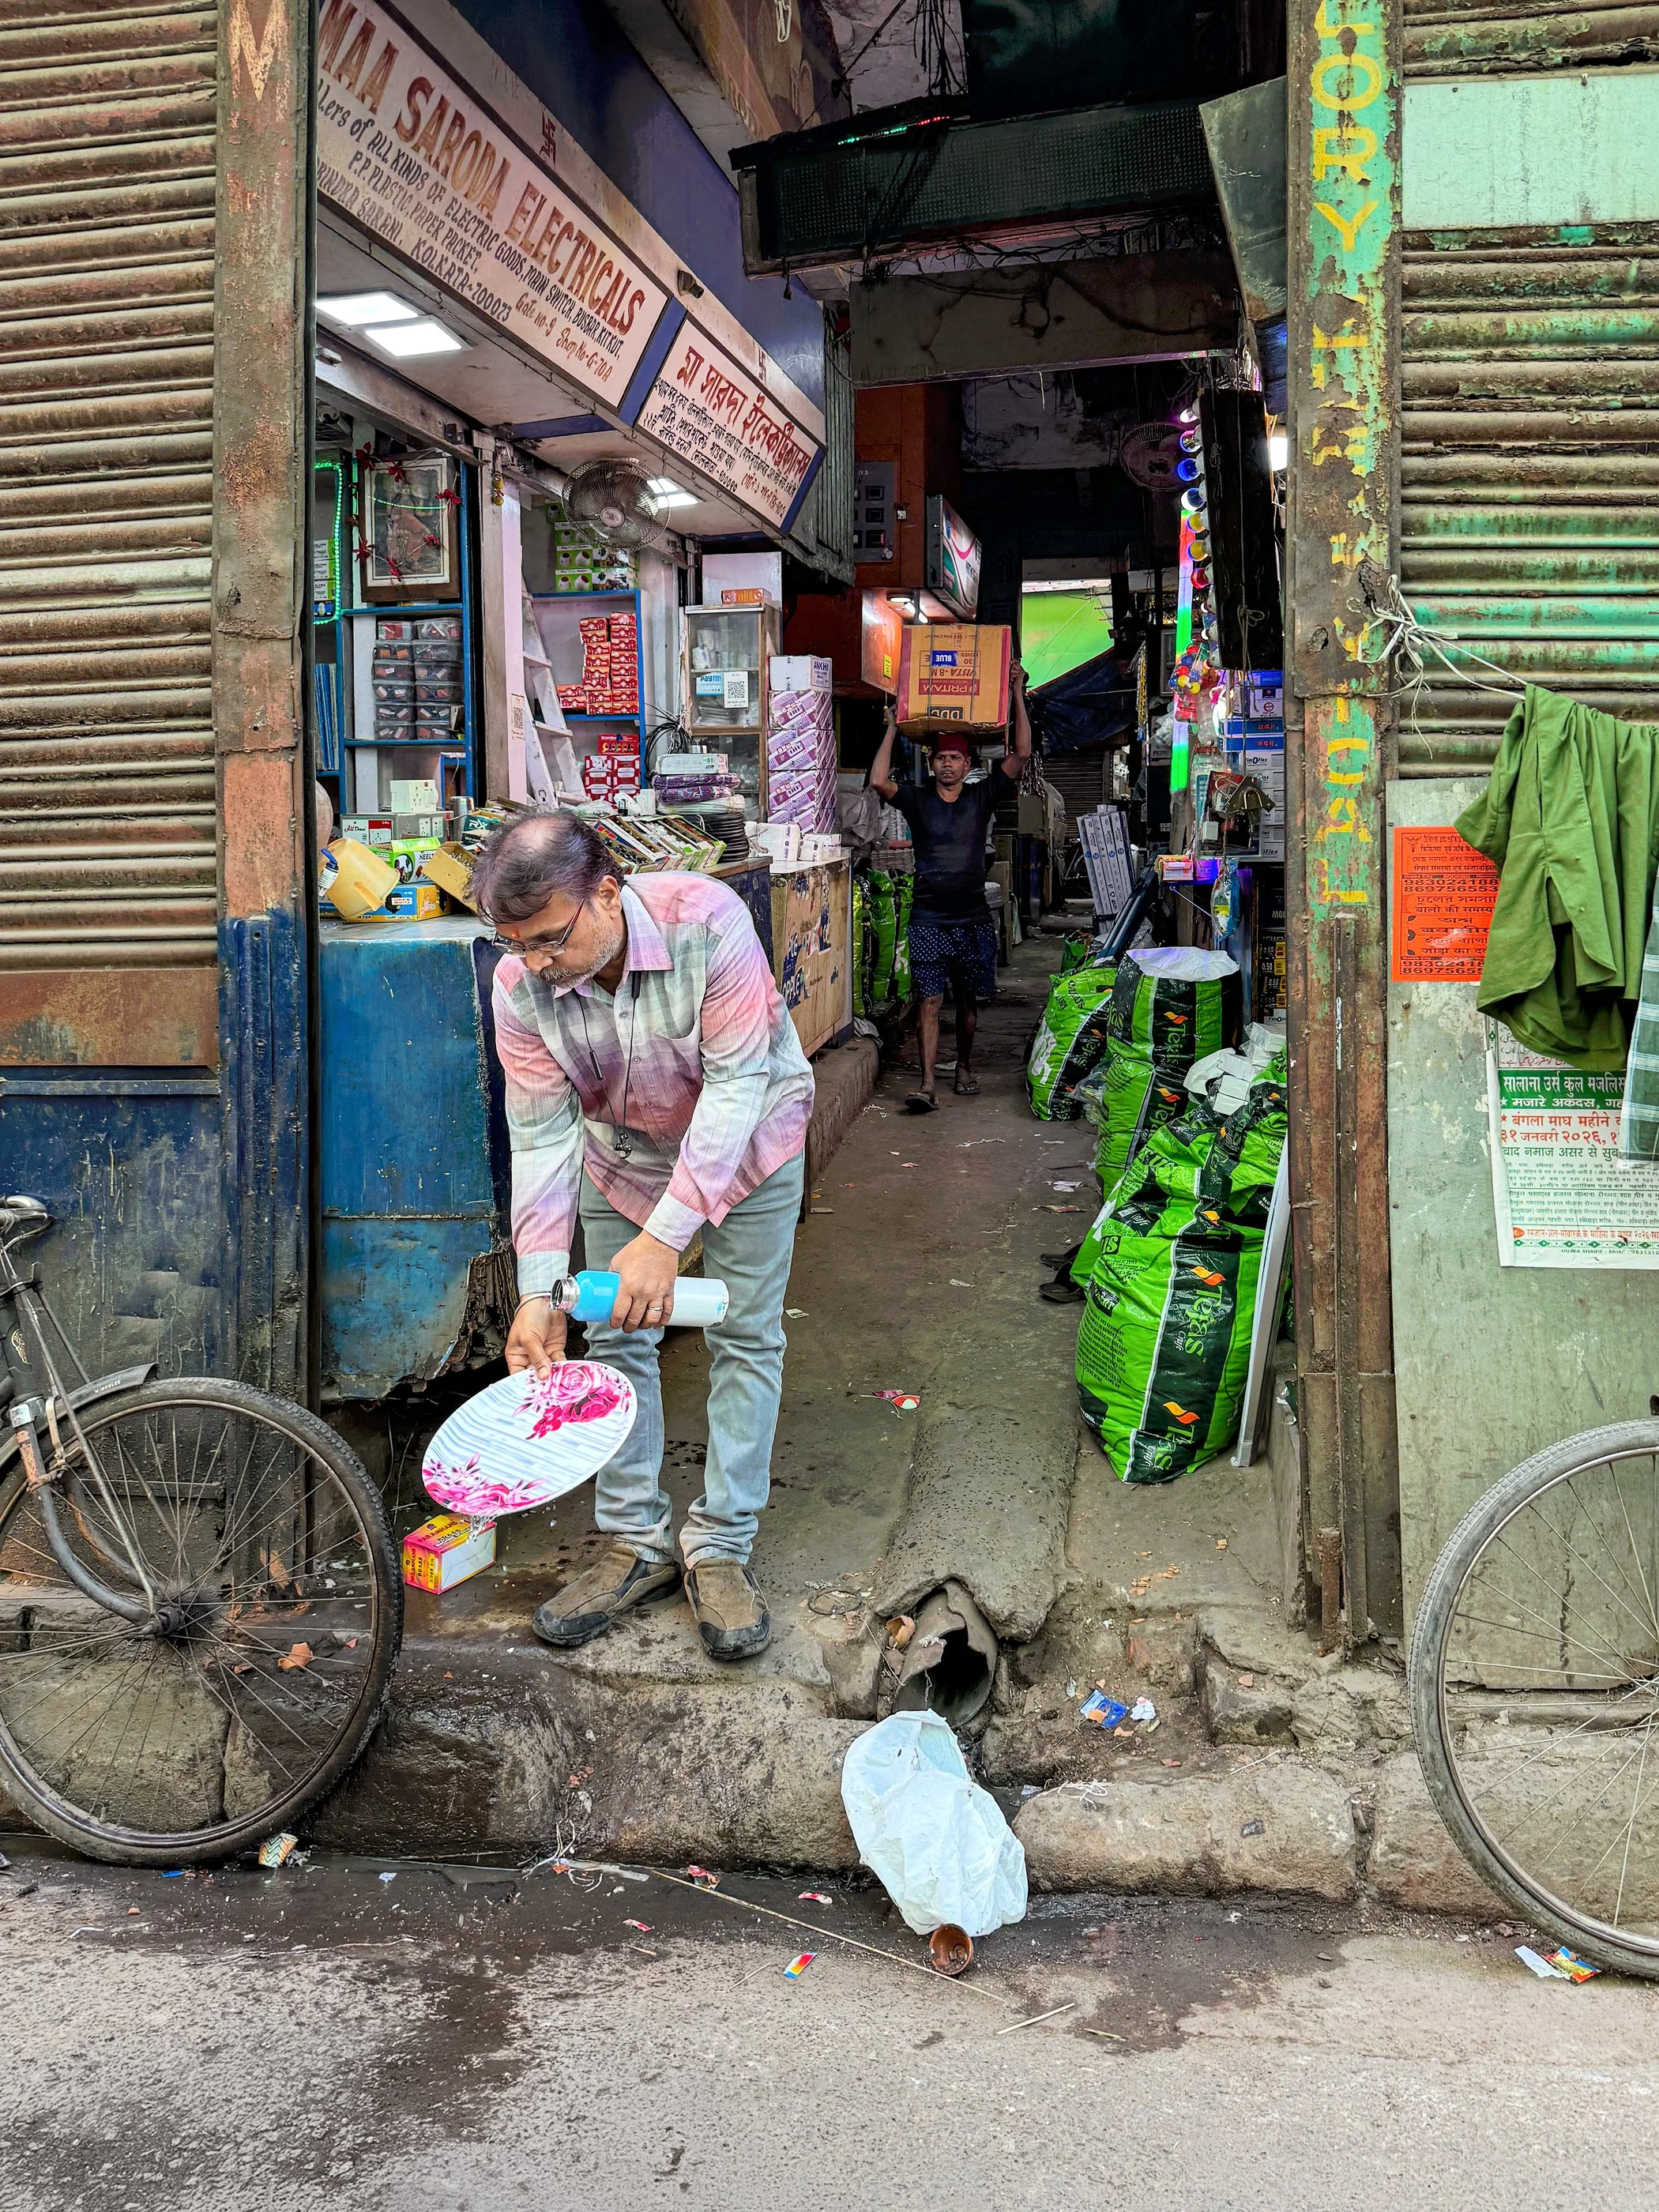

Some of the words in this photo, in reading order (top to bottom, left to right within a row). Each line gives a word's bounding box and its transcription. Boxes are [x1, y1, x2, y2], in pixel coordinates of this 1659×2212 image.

[318, 0, 399, 115] MAA
[393, 76, 512, 222] SARODA
[504, 180, 645, 336] ELECTRICALS
[350, 118, 375, 143] of
[367, 130, 393, 164] ALL
[389, 148, 430, 191] KINDS
[427, 180, 447, 205] OF
[444, 195, 499, 252] ELECTRIC
[522, 265, 551, 299] MAIN
[409, 201, 445, 241] PAPER
[515, 292, 535, 320] Gate
[555, 327, 576, 359] Shop
[676, 345, 705, 389] মা
[700, 363, 749, 427] সারদা
[924, 684, 968, 693] PRITAM
[1503, 1076, 1540, 1093] सालाना
[1543, 1071, 1560, 1093] उर्स
[1563, 1076, 1583, 1097] कुल
[1511, 1095, 1547, 1107] मजारे
[1511, 1112, 1544, 1127] बंगला
[1548, 1115, 1572, 1127] माघ
[1577, 1112, 1611, 1128] महीने
[1520, 1128, 1559, 1142] जनवरी
[1525, 1146, 1554, 1157] नमाज
[1559, 1146, 1583, 1157] असर
[1588, 1145, 1598, 1157] से
[1185, 1285, 1224, 1356] Tejas
